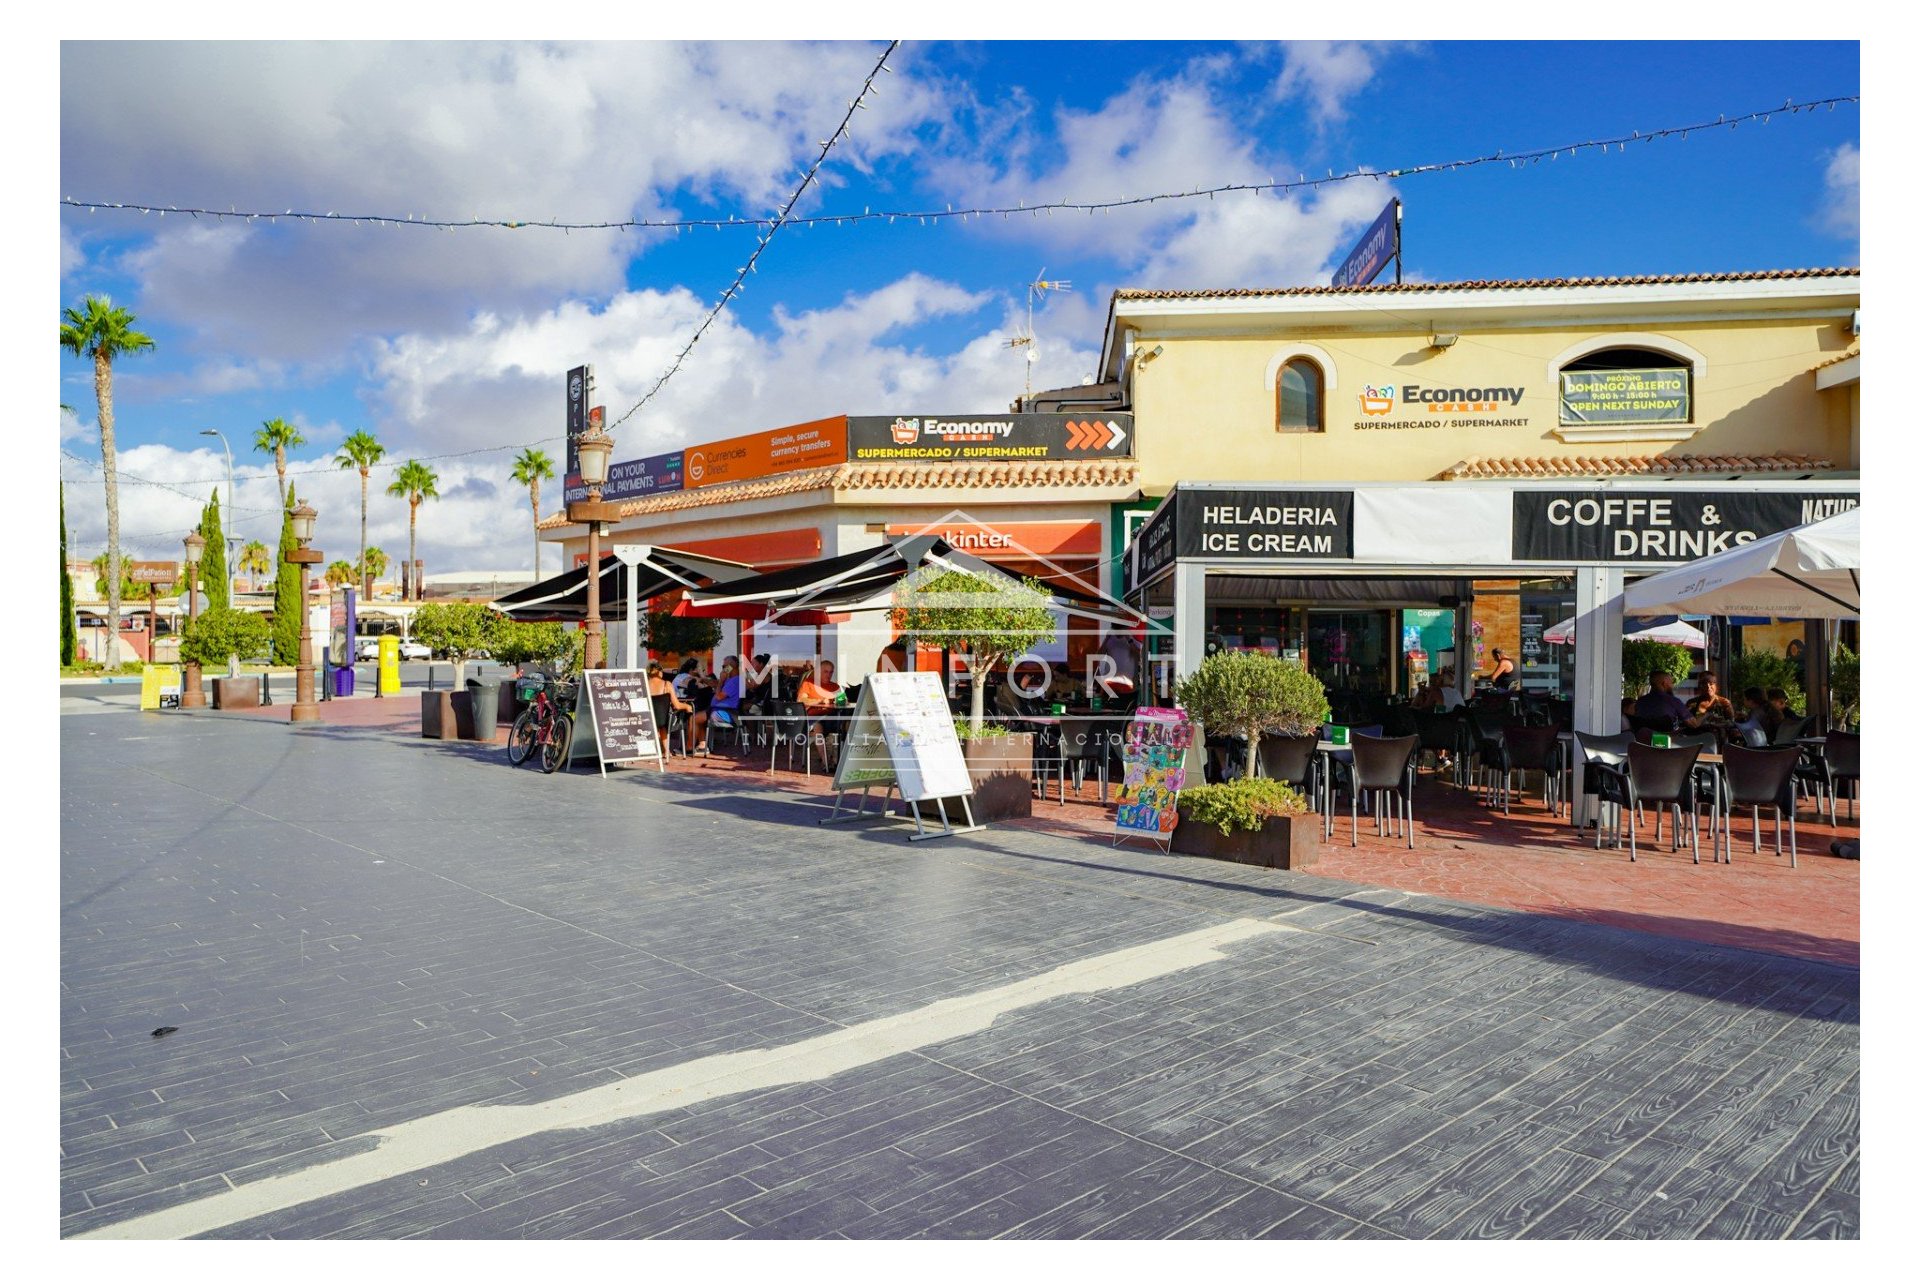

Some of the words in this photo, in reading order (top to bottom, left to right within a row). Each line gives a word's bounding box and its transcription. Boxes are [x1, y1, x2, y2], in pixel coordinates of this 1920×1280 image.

[1568, 382, 1626, 392] DOMINGO
[1628, 380, 1681, 391] ABIERTO
[1402, 385, 1525, 406] Economy
[1591, 392, 1611, 400] 9:00
[1626, 391, 1649, 400] 15:00
[1650, 391, 1657, 399] h
[1436, 403, 1490, 412] CASH
[1570, 402, 1600, 411] OPEN
[1602, 401, 1631, 411] NEXT
[1633, 399, 1680, 410] SUNDAY
[924, 419, 1014, 438] Economy
[1354, 420, 1441, 430] SUPERMERCADO
[1451, 418, 1529, 427] SUPERMARKET
[796, 430, 819, 441] secure
[706, 447, 747, 463] Currencies
[857, 448, 952, 458] SUPERMERCADO
[963, 446, 1049, 457] SUPERMARKET
[611, 466, 624, 480] ON
[625, 462, 646, 478] YOUR
[706, 463, 729, 476] Direct
[565, 482, 616, 501] INTERNNAL
[616, 475, 654, 493] PAYMENTS
[1203, 506, 1338, 526] HELADERIA
[1547, 498, 1672, 526] COFFE
[1700, 503, 1722, 525] &
[1202, 533, 1240, 552] ICE
[1247, 533, 1332, 553] CREAM
